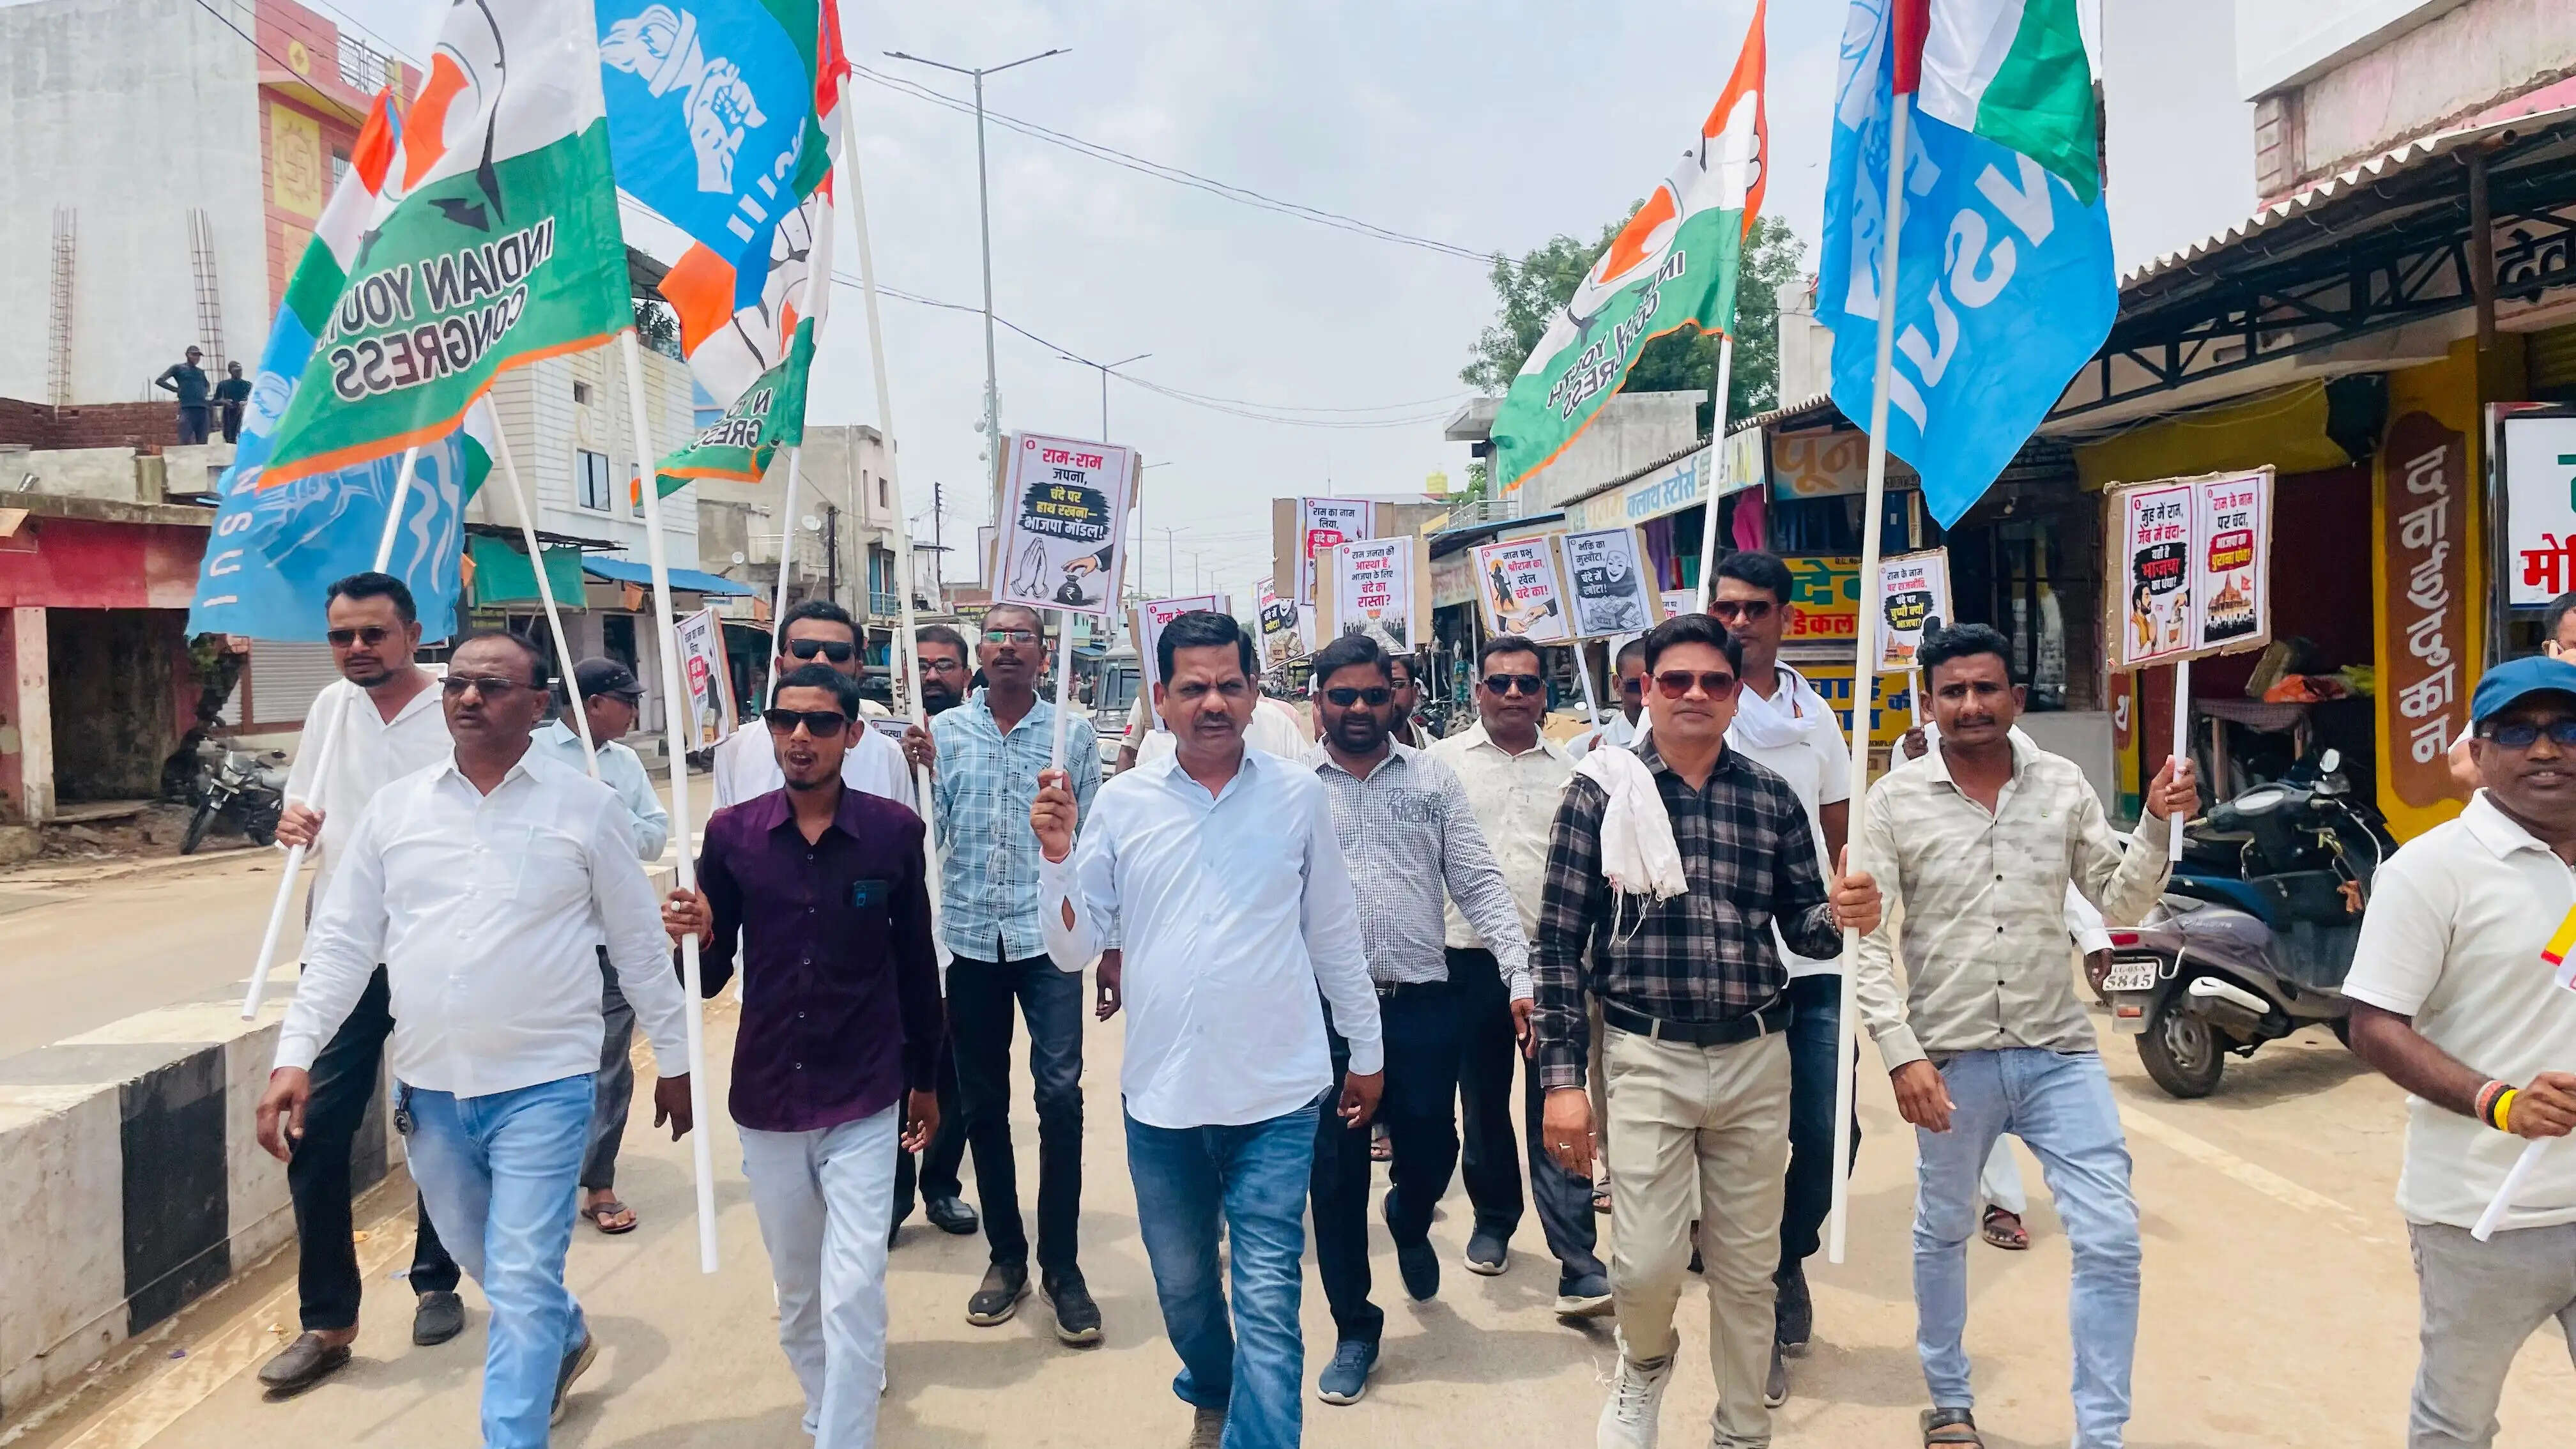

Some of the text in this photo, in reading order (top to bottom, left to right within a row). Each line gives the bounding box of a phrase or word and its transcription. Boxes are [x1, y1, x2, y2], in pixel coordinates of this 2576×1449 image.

[1042, 448, 1103, 470] राम-राम
[1052, 468, 1087, 486] जपना,
[1050, 486, 1082, 503] चंदे पर
[1313, 507, 1327, 516] राम
[1328, 509, 1338, 517] का
[1024, 516, 1104, 539] भाजपा मॉडल!
[1319, 518, 1338, 530] लिया,
[1376, 582, 1386, 592] का
[1357, 595, 1391, 608] रास्ता?
[2106, 974, 2151, 989] 5845
